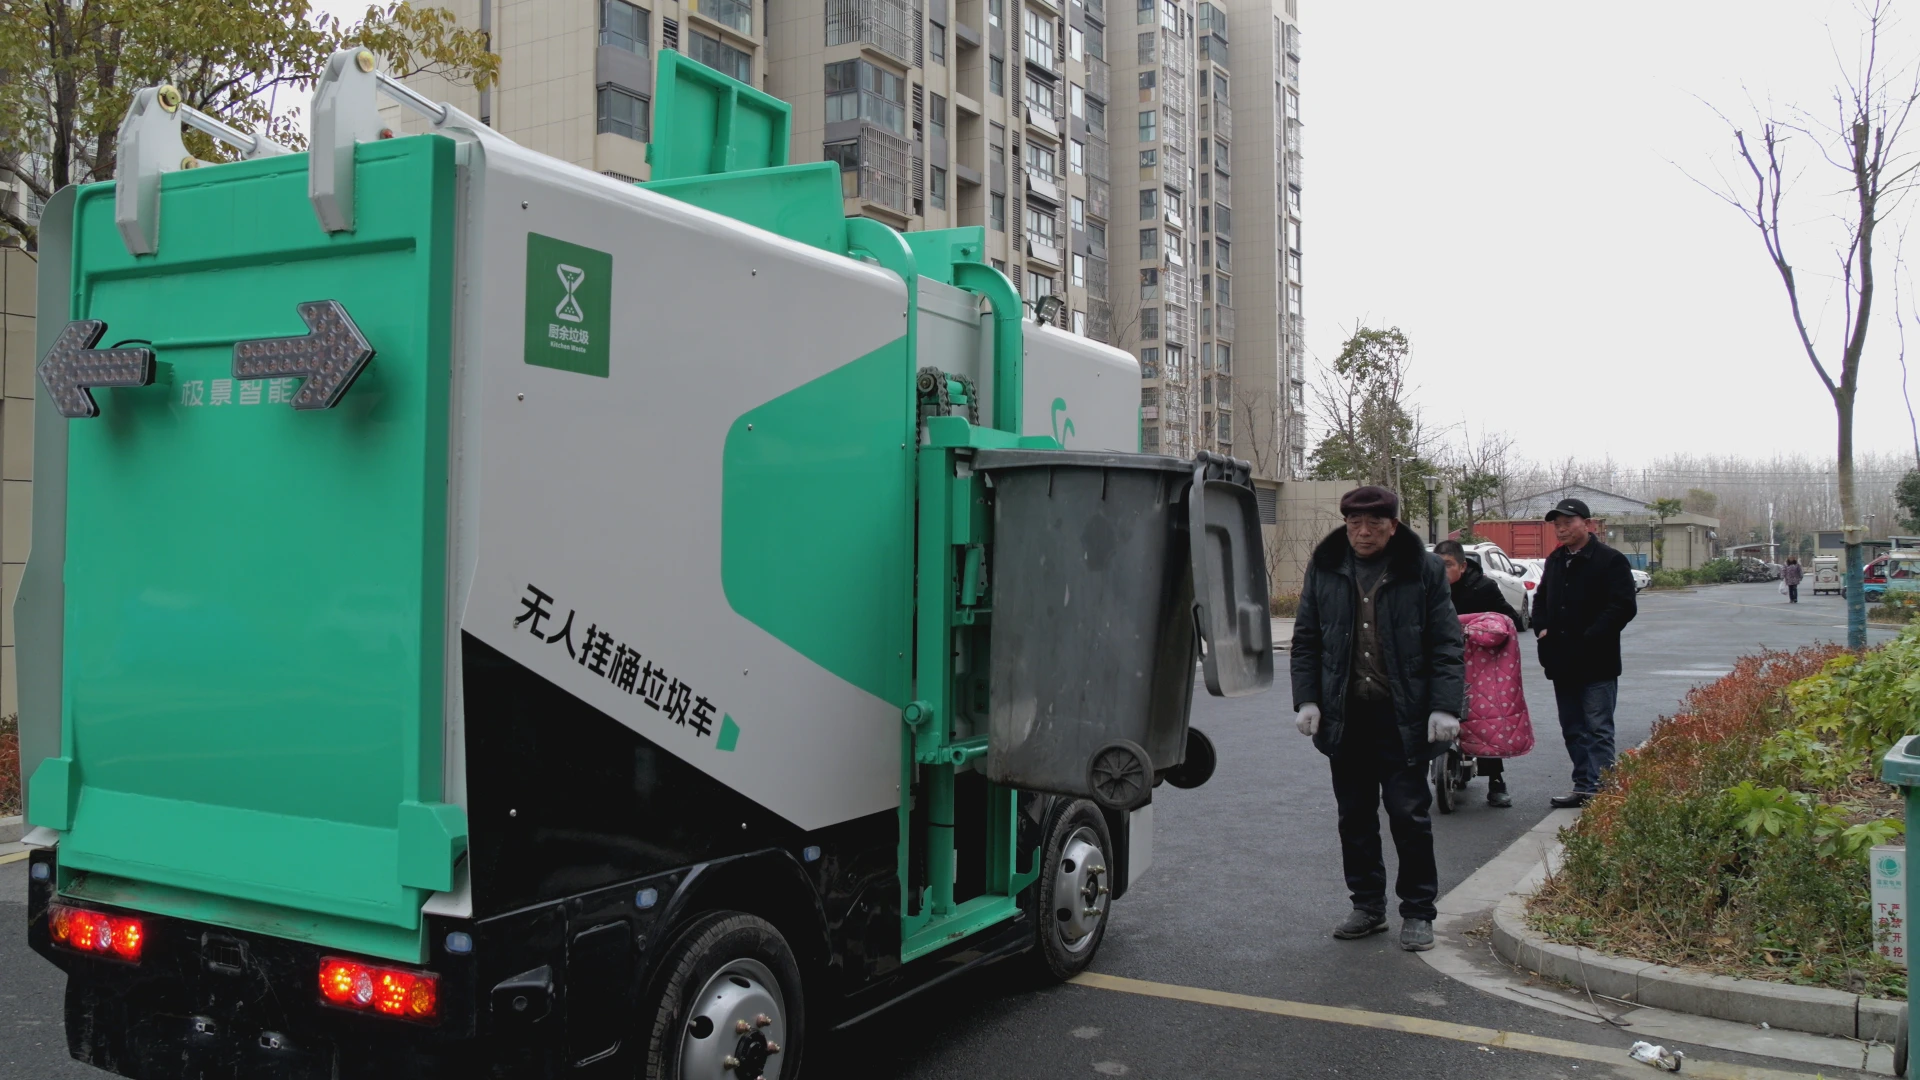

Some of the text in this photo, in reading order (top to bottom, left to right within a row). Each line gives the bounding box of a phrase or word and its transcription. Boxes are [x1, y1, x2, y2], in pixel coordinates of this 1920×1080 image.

[548, 323, 589, 345] 厨余垃圾
[550, 341, 587, 353] Kitchen Waste
[181, 378, 293, 406] 极景智能
[515, 583, 717, 738] 无人挂桶垃圾车
[1891, 903, 1903, 957] 严禁开挖
